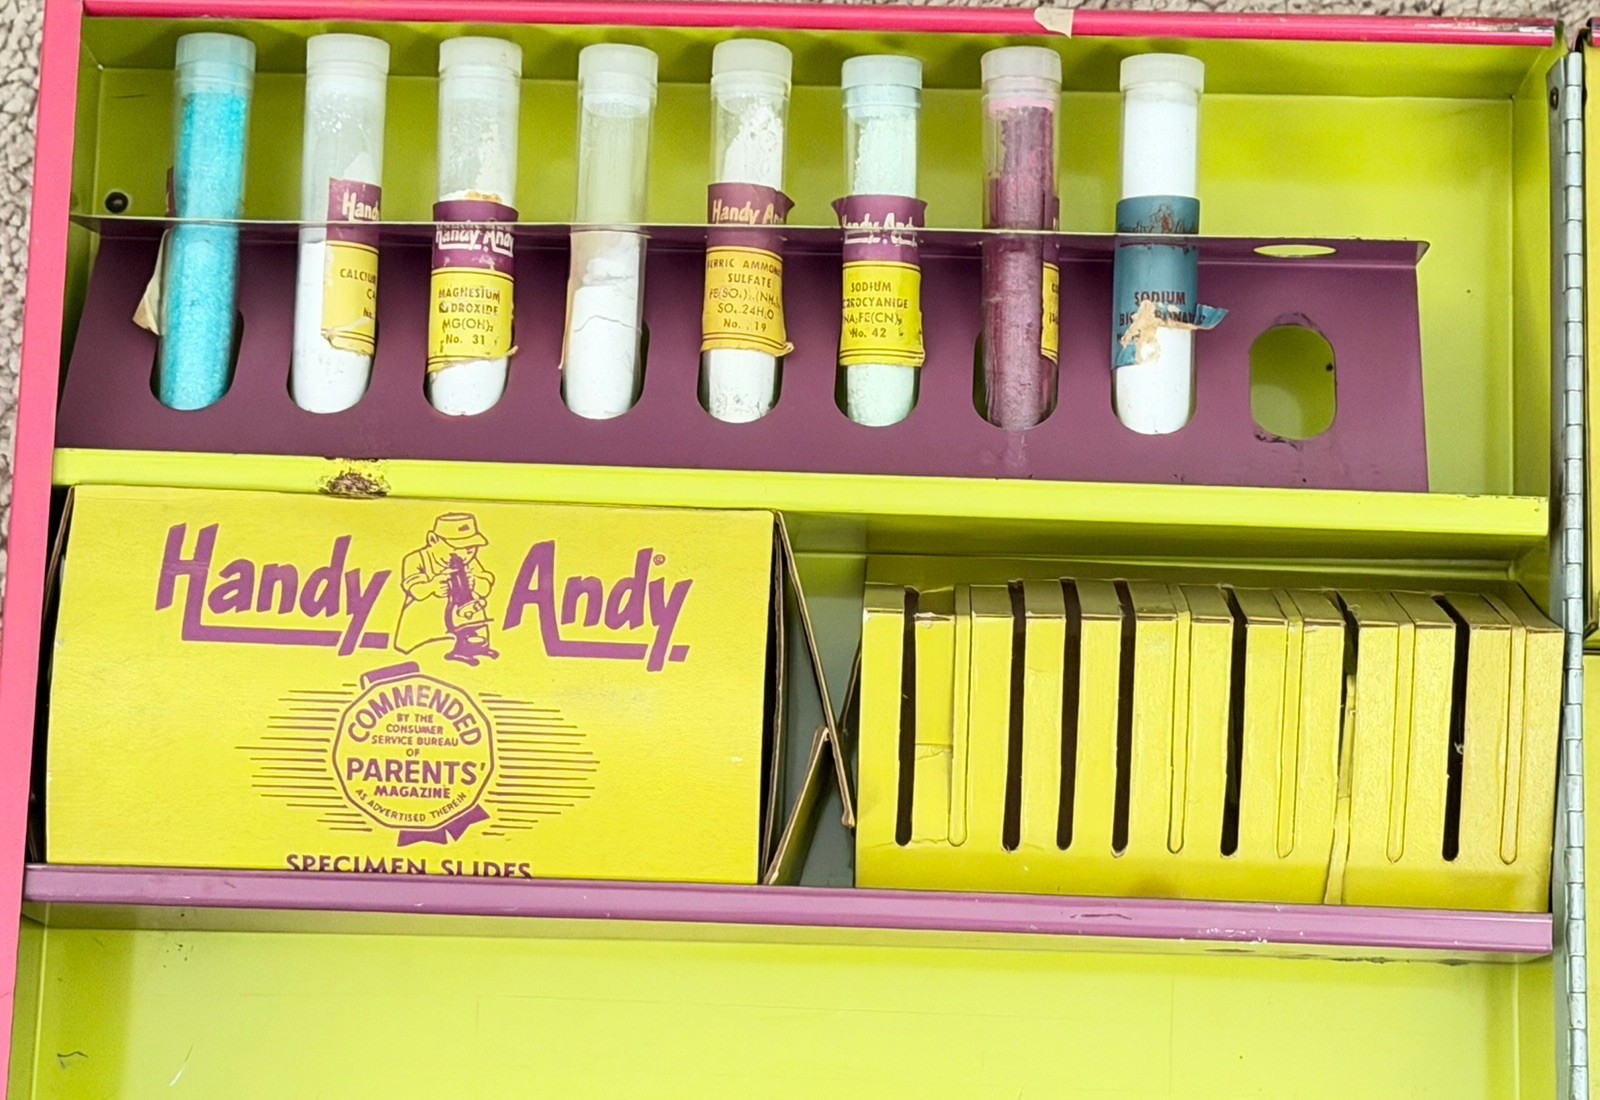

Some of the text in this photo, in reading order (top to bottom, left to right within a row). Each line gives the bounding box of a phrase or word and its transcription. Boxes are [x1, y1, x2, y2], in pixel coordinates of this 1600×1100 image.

[712, 199, 761, 225] Handy
[727, 273, 772, 289] SULFATE
[850, 281, 892, 293] SODIUM
[438, 286, 501, 303] MAGNESIUM
[1134, 290, 1186, 307] SODIUM
[723, 318, 767, 333] No. 19
[850, 327, 887, 338] No. 42
[445, 333, 485, 345] No. 31
[155, 522, 694, 672] Handy Andy
[348, 684, 482, 746] COMMENDED
[396, 713, 434, 723] BY THE
[386, 724, 444, 735] CONSUMER
[371, 734, 459, 747] SERVICE BUREAU
[406, 748, 421, 757] OF
[346, 757, 486, 785] PARENTS'
[374, 785, 451, 799] MAGAZINE
[355, 788, 467, 822] AS ADVERTISED THEREIN
[286, 853, 427, 876] SPECIMEN
